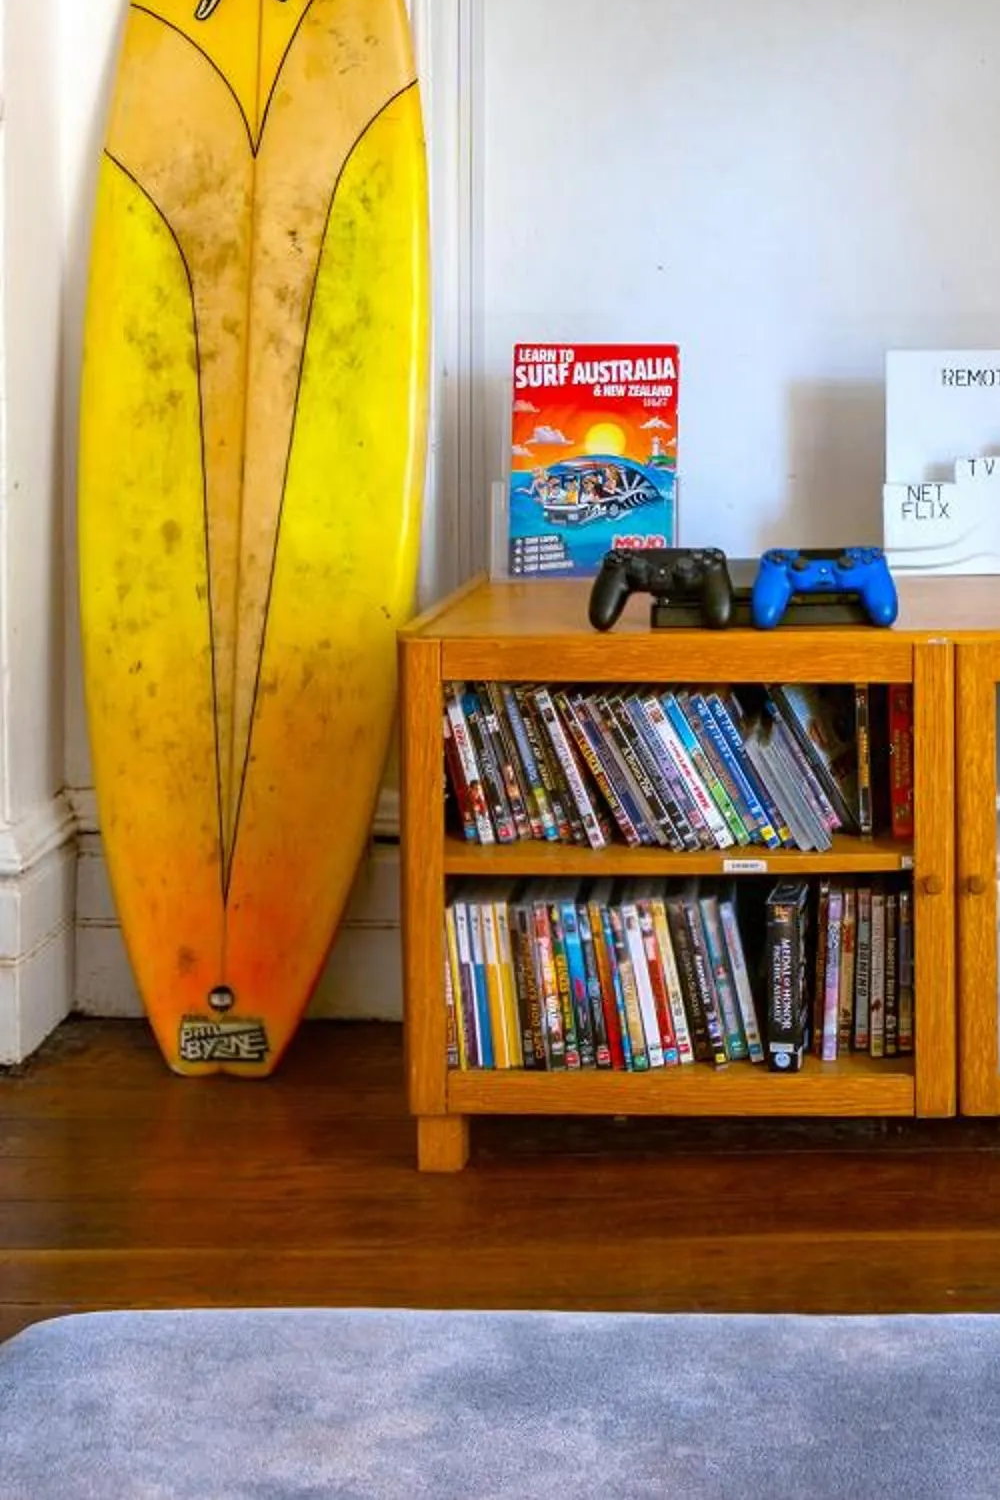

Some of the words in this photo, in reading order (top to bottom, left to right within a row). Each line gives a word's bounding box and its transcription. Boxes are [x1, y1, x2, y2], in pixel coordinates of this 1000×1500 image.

[519, 348, 556, 363] LEARN
[559, 348, 575, 363] TO
[515, 363, 569, 388] SURF
[572, 357, 676, 386] AUSTRALIA
[593, 385, 602, 397] &
[603, 385, 625, 397] NEW
[628, 384, 672, 397] ZEALAND
[906, 484, 944, 502] NET
[901, 502, 951, 520] FLIX
[780, 939, 791, 975] MEDAL
[782, 988, 792, 1030] HONOR
